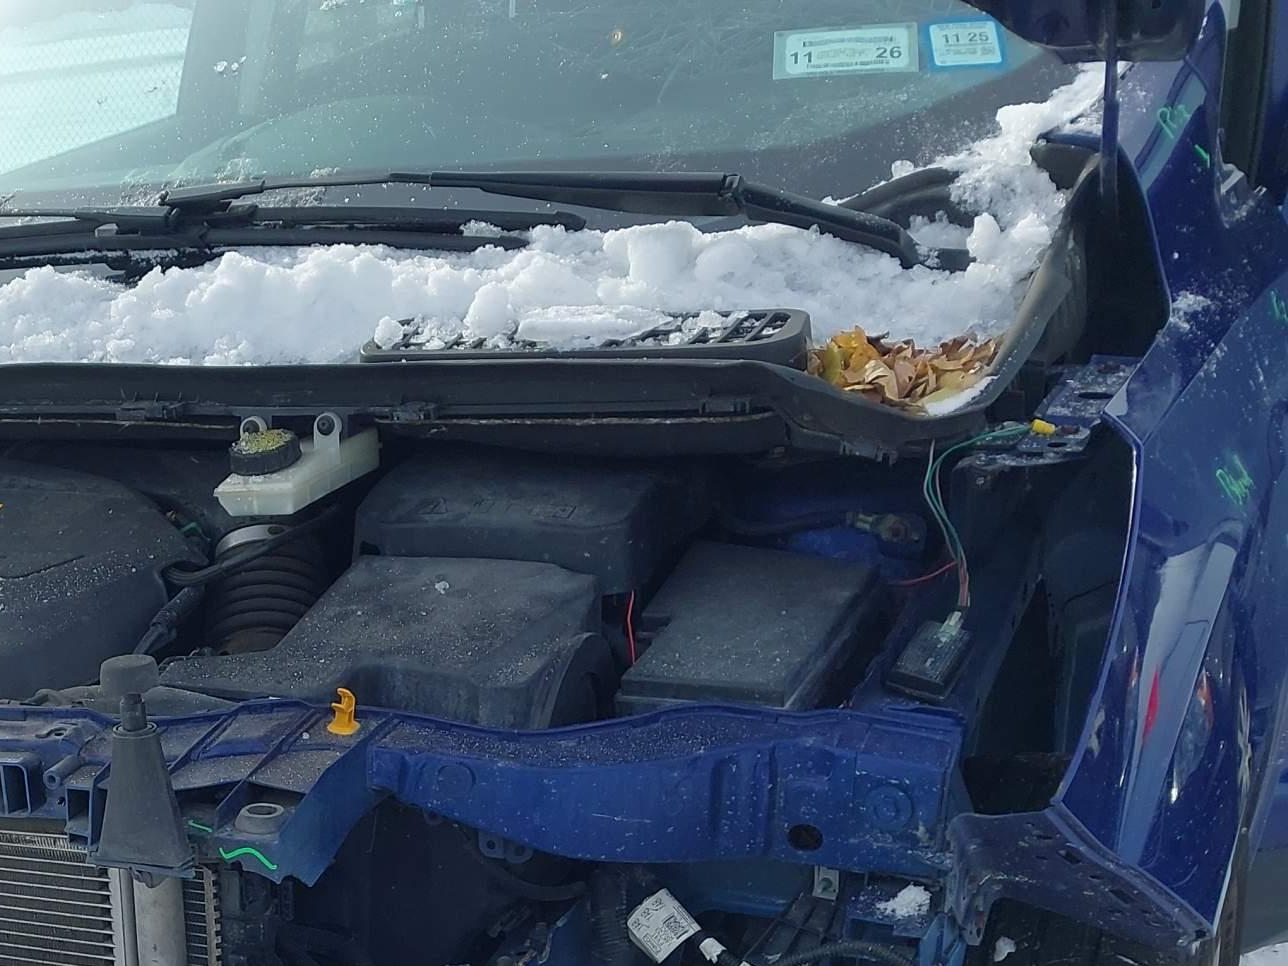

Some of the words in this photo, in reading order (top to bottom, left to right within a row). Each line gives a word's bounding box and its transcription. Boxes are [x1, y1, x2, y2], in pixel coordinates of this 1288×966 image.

[941, 32, 959, 43] 11
[968, 31, 989, 42] 25
[790, 51, 813, 64] 11
[876, 46, 902, 59] 26
